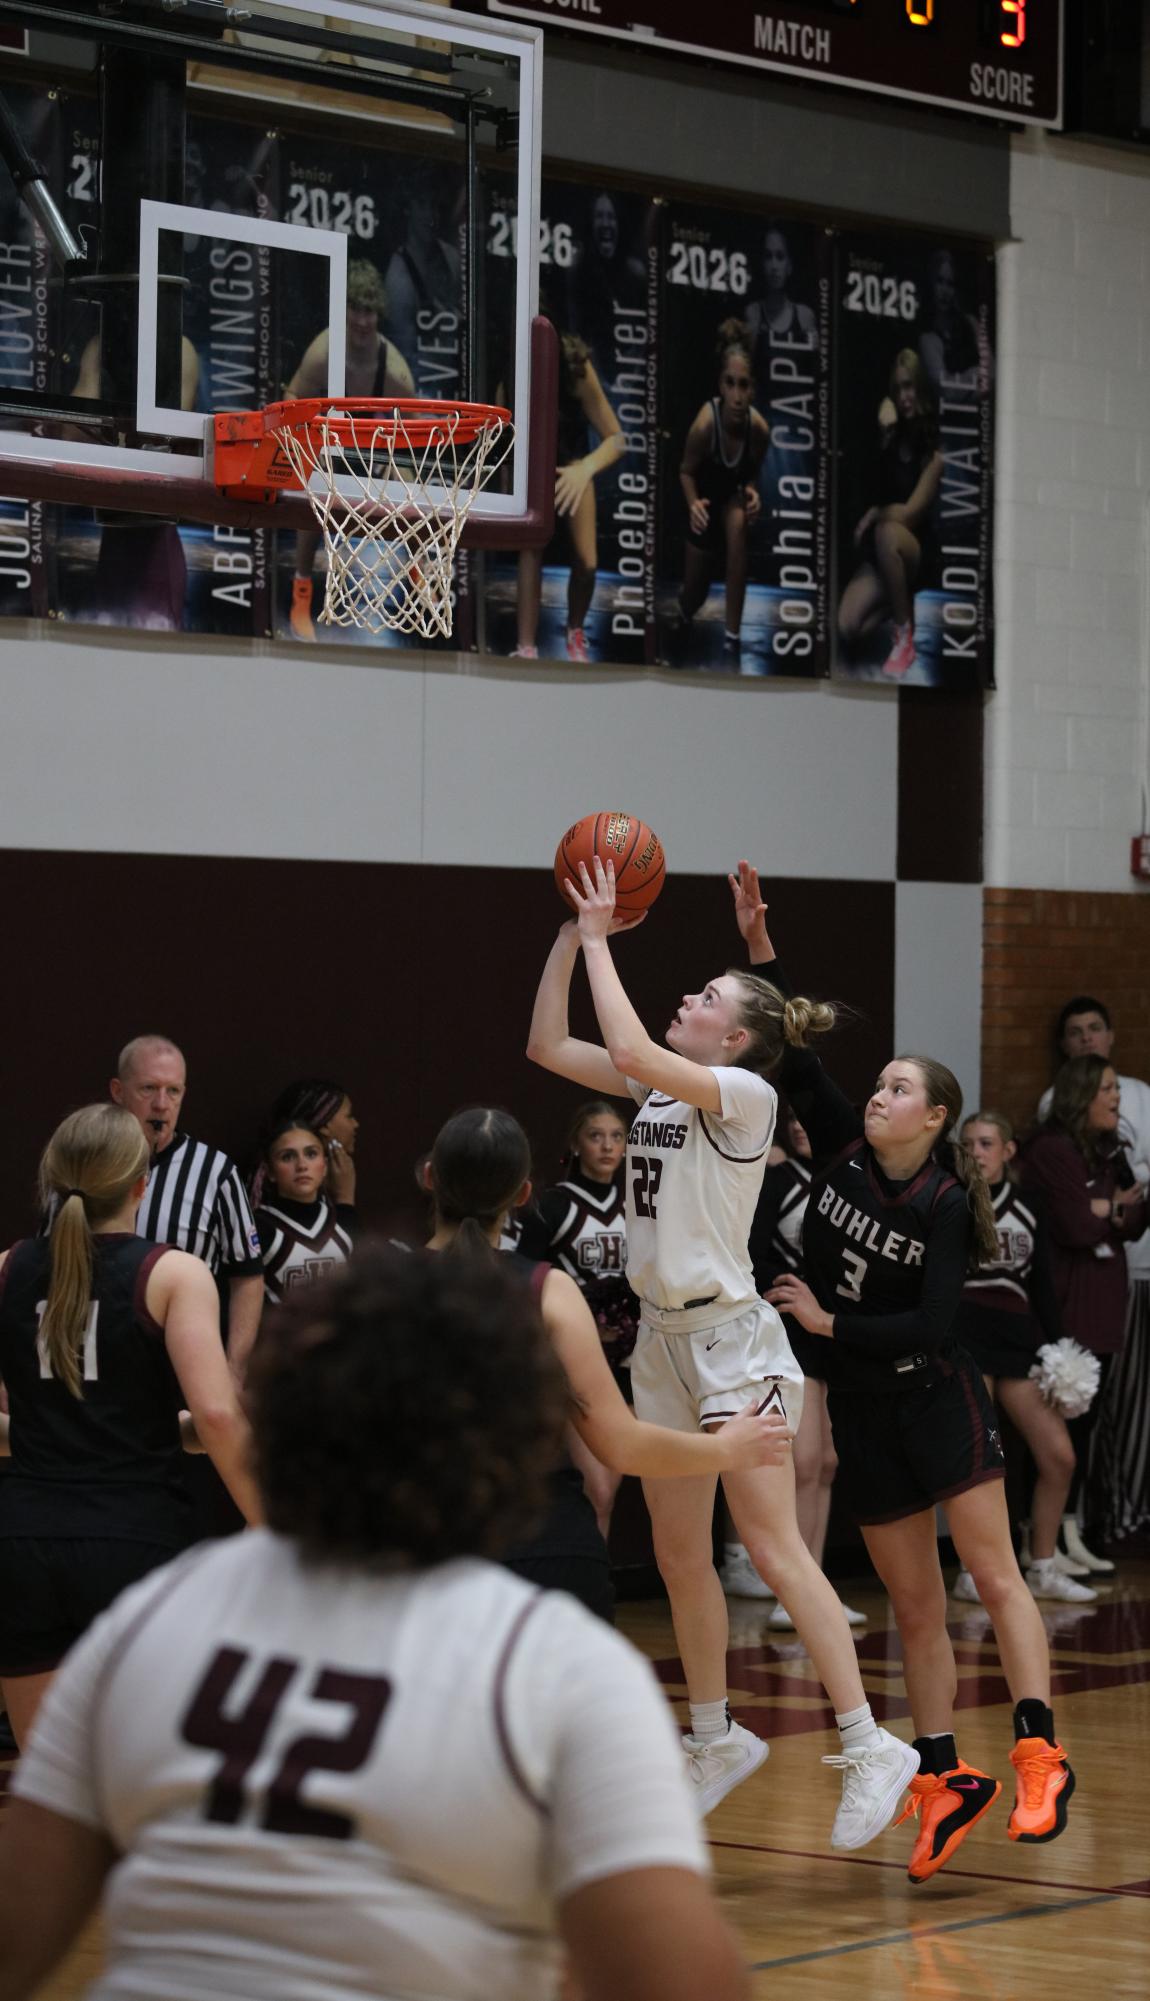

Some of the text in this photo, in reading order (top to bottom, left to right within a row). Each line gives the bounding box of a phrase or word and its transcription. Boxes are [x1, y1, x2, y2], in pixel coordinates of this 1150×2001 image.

[753, 14, 831, 63] MATCH
[969, 62, 1035, 107] SCORE
[289, 161, 333, 184] Senior
[286, 184, 378, 241] 2026
[667, 240, 750, 296] 2026
[845, 271, 919, 321] 2026
[35, 277, 48, 353] SCHOOL
[258, 305, 270, 380] SCHOOL
[611, 297, 648, 637] Phoebe Bohrer
[644, 246, 659, 625] SALINA CENTRAL HIGH SCHOOL WRESTLING
[816, 277, 830, 643] SALINA CENTRAL HIGH SCHOOL WRESTLING
[769, 329, 819, 657] Sophia CAPE
[939, 371, 981, 658] KODI WAITE
[31, 500, 44, 565] SALINA
[626, 1121, 689, 1150] USTANGS
[631, 1155, 663, 1220] 22
[577, 1231, 627, 1272] CH
[816, 1183, 927, 1266] BUHLER
[835, 1247, 868, 1303] 3
[180, 1645, 392, 1840] 42
